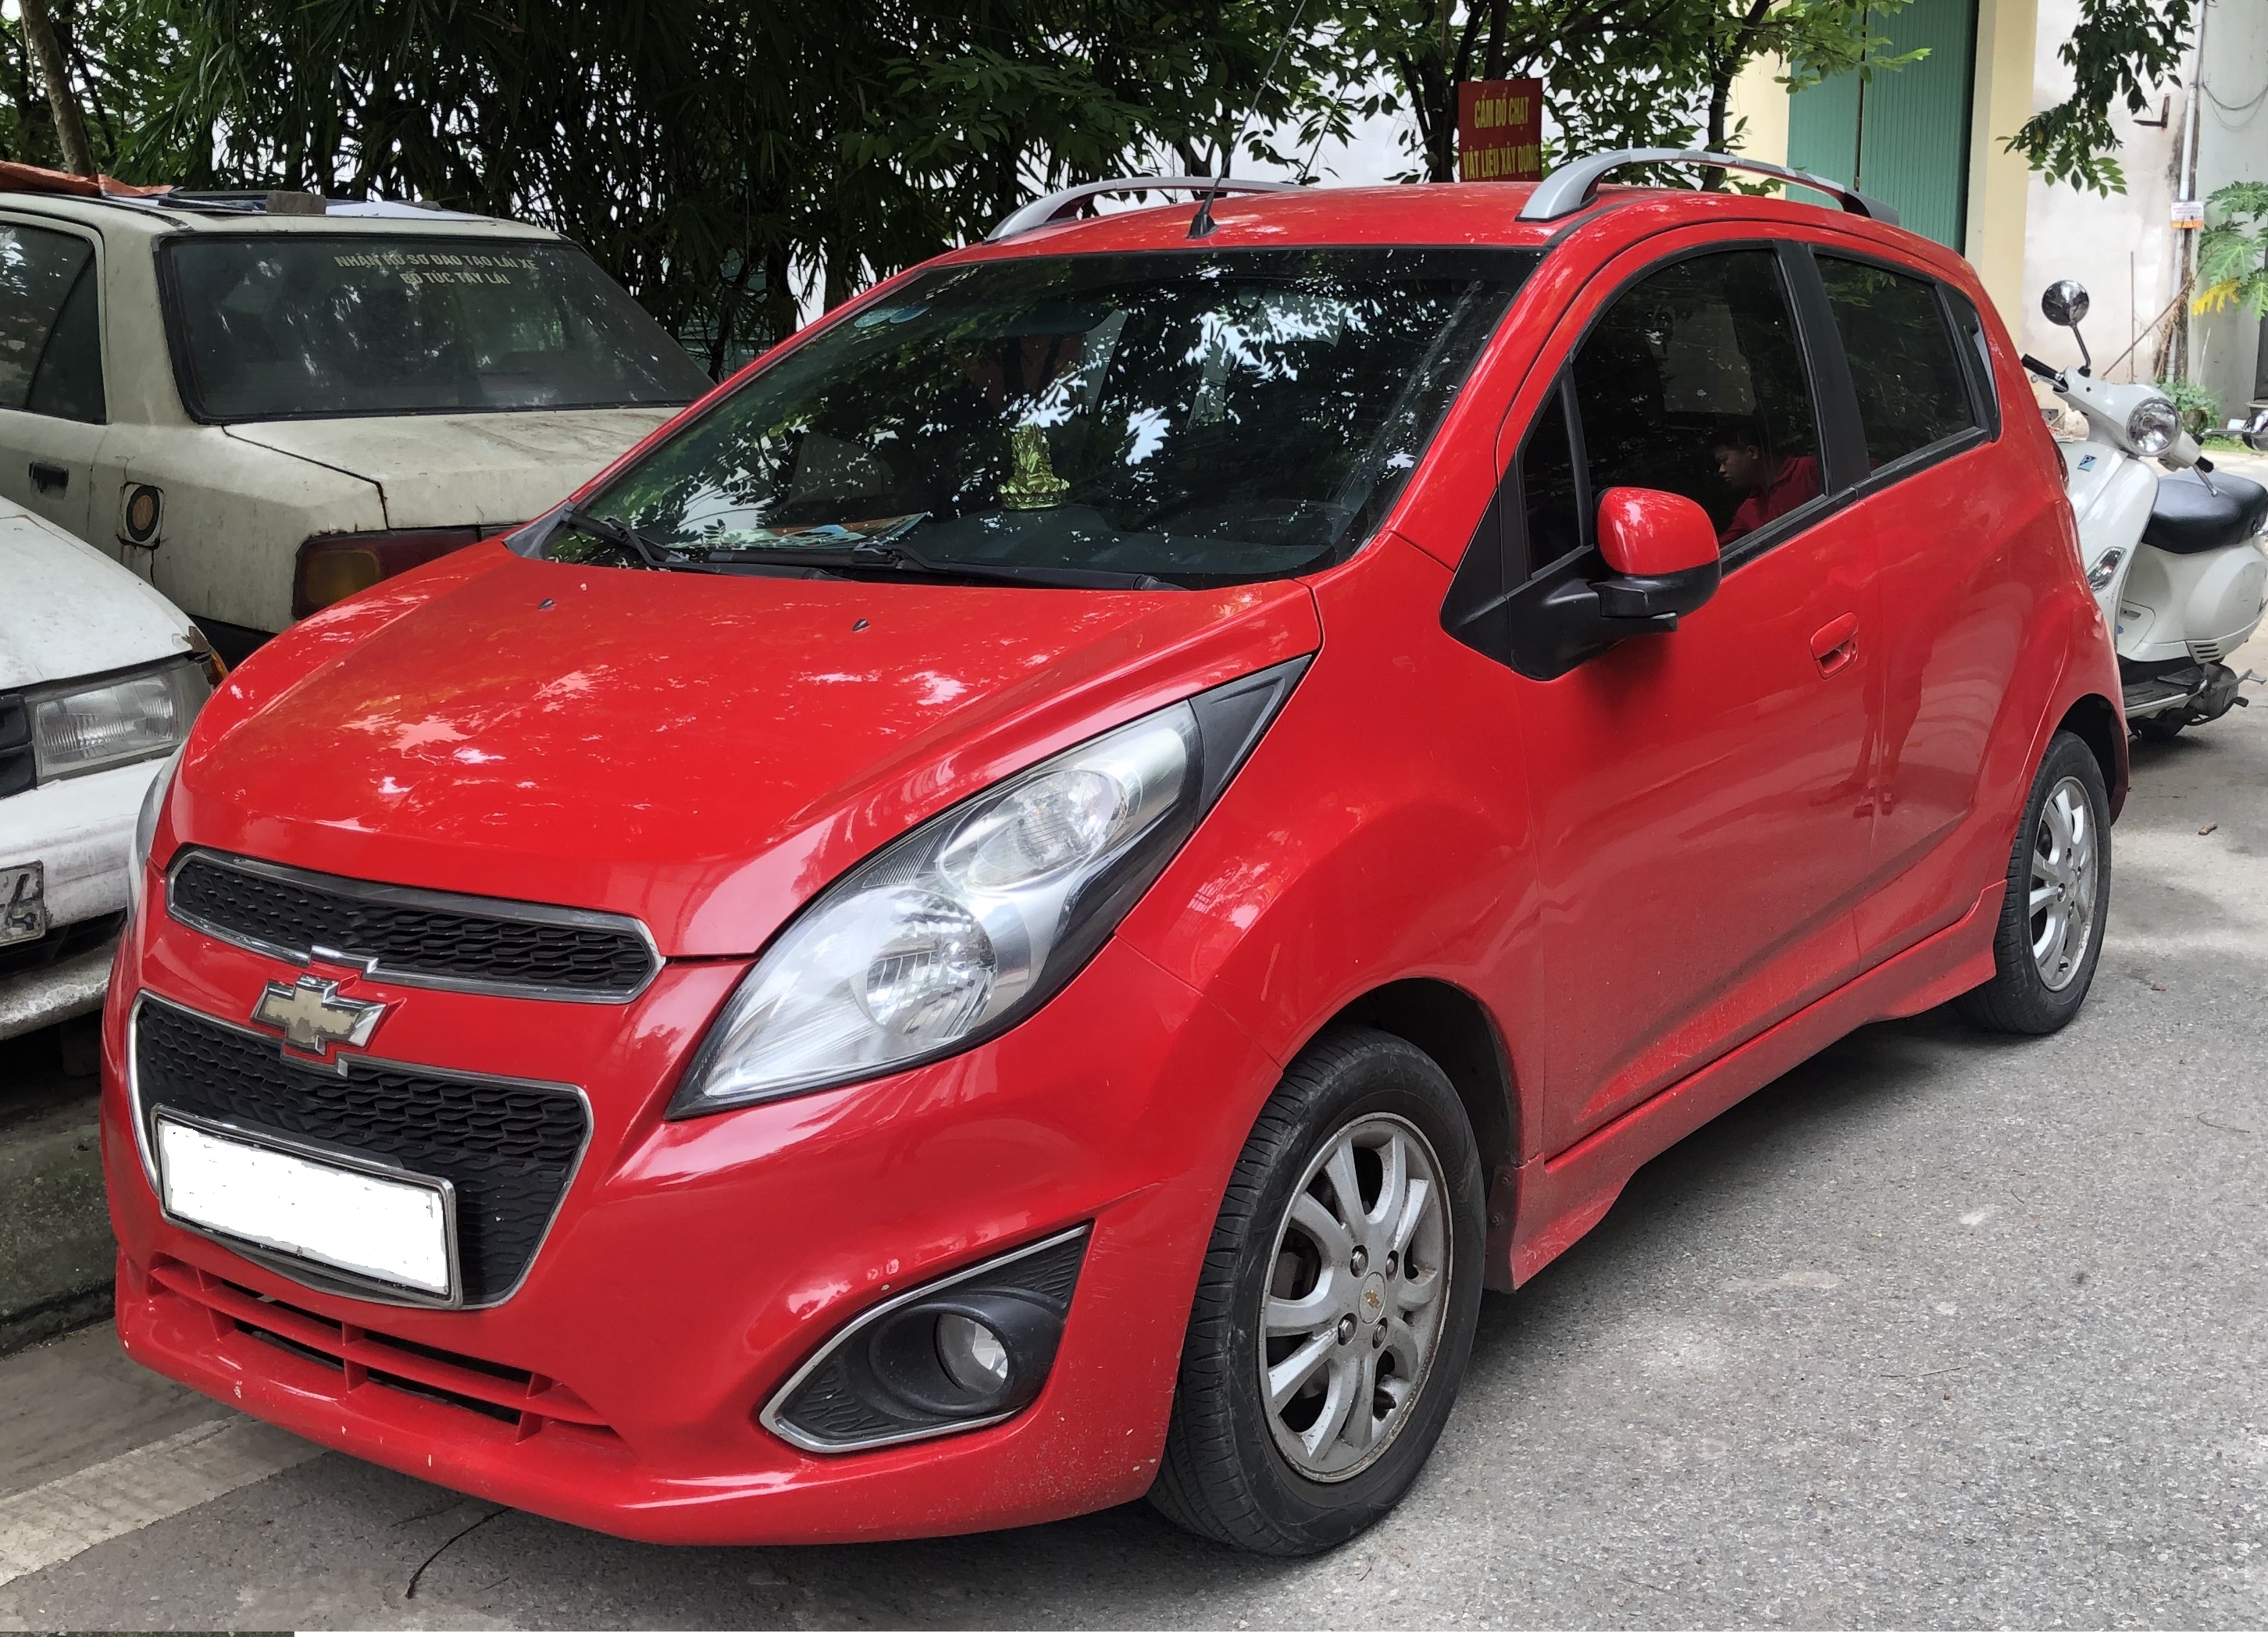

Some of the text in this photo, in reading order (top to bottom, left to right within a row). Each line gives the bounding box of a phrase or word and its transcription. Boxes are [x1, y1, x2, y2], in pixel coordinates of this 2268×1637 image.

[1475, 89, 1494, 129] CẤM
[1500, 141, 1516, 175] XÂY
[406, 253, 430, 266] SƠ
[462, 255, 493, 268] TẠO
[517, 259, 539, 270] XE
